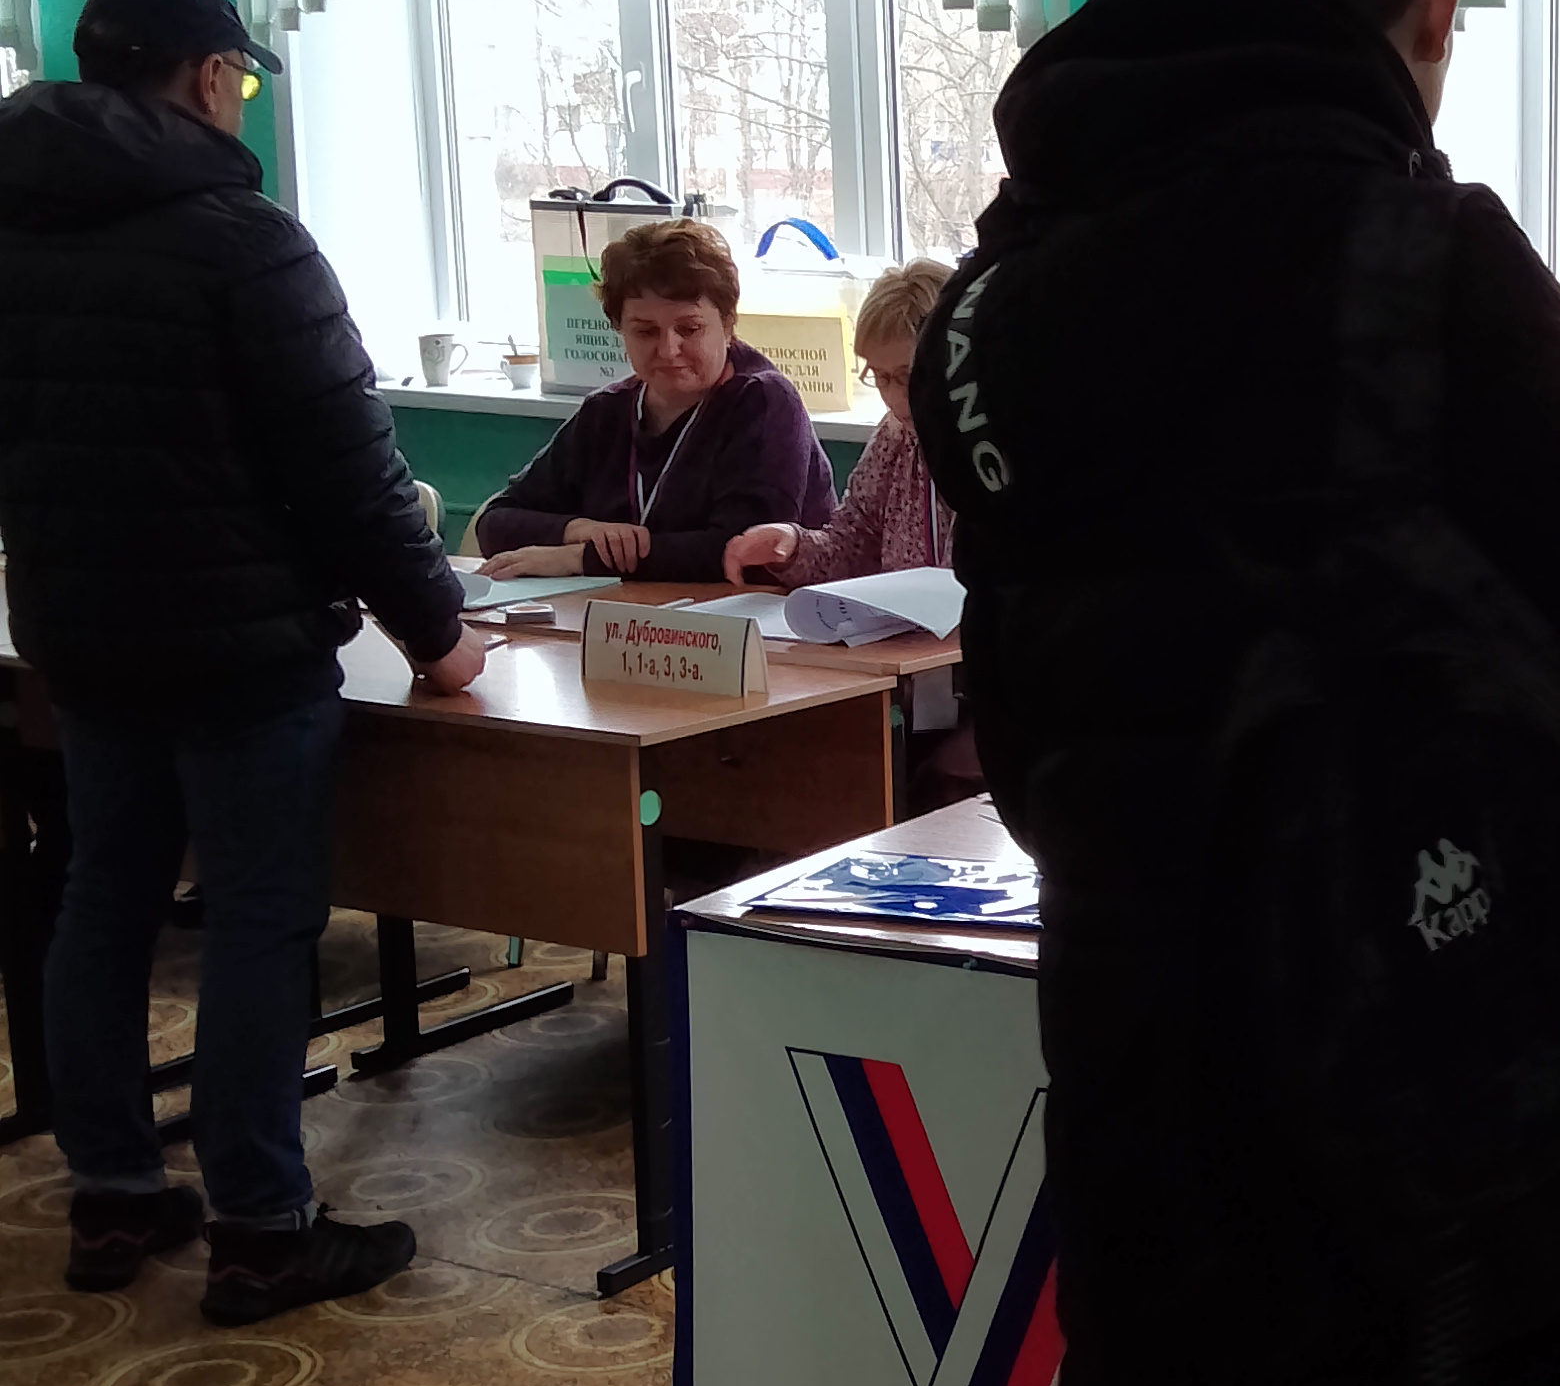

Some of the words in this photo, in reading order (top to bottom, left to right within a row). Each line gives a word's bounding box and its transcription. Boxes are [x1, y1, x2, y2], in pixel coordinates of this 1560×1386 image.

[566, 317, 611, 331] ПЕРЕНО
[575, 334, 610, 347] ЯЩИК
[564, 348, 628, 364] ГОЛОСОВА
[755, 346, 828, 361] РЕНОСНОЙ
[794, 364, 820, 377] ДЛЯ
[605, 621, 623, 644] ул.
[625, 618, 722, 656] Дубровинского,
[621, 650, 633, 678] 1,
[663, 654, 676, 682] 3,
[1416, 887, 1492, 952] Kapp
